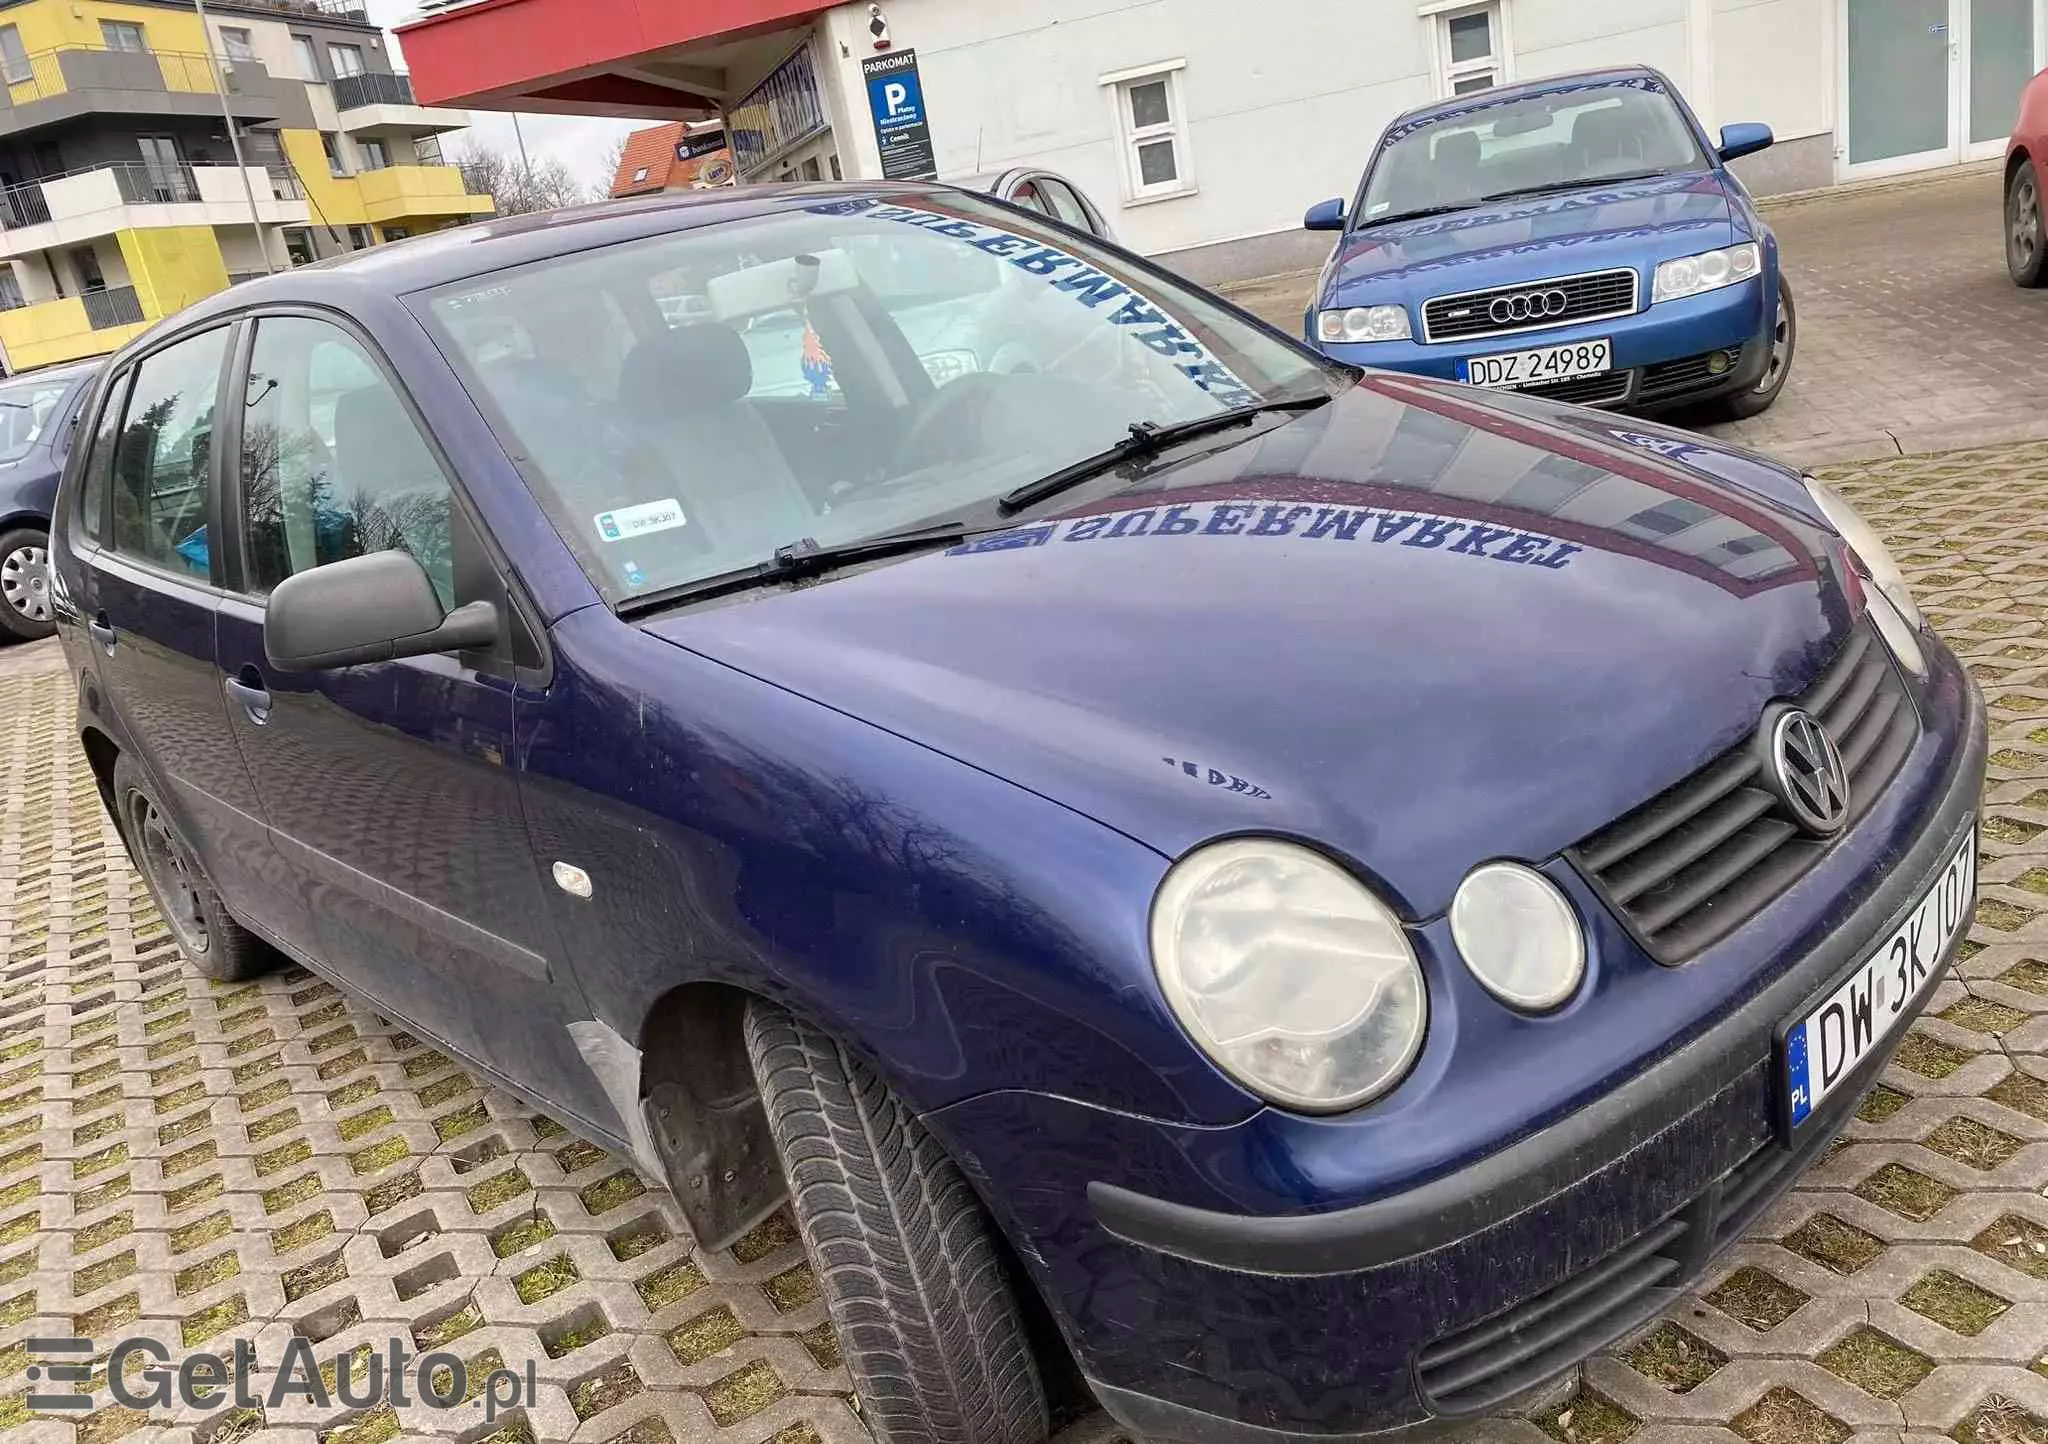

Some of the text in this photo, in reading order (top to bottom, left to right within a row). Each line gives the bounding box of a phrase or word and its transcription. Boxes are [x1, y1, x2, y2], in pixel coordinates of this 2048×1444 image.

[864, 54, 915, 74] PARKOMAT
[885, 82, 906, 116] P
[1471, 343, 1606, 385] DDZ 24989
[1819, 840, 1971, 1091] DW 3KJ07
[1791, 1084, 1808, 1113] PL
